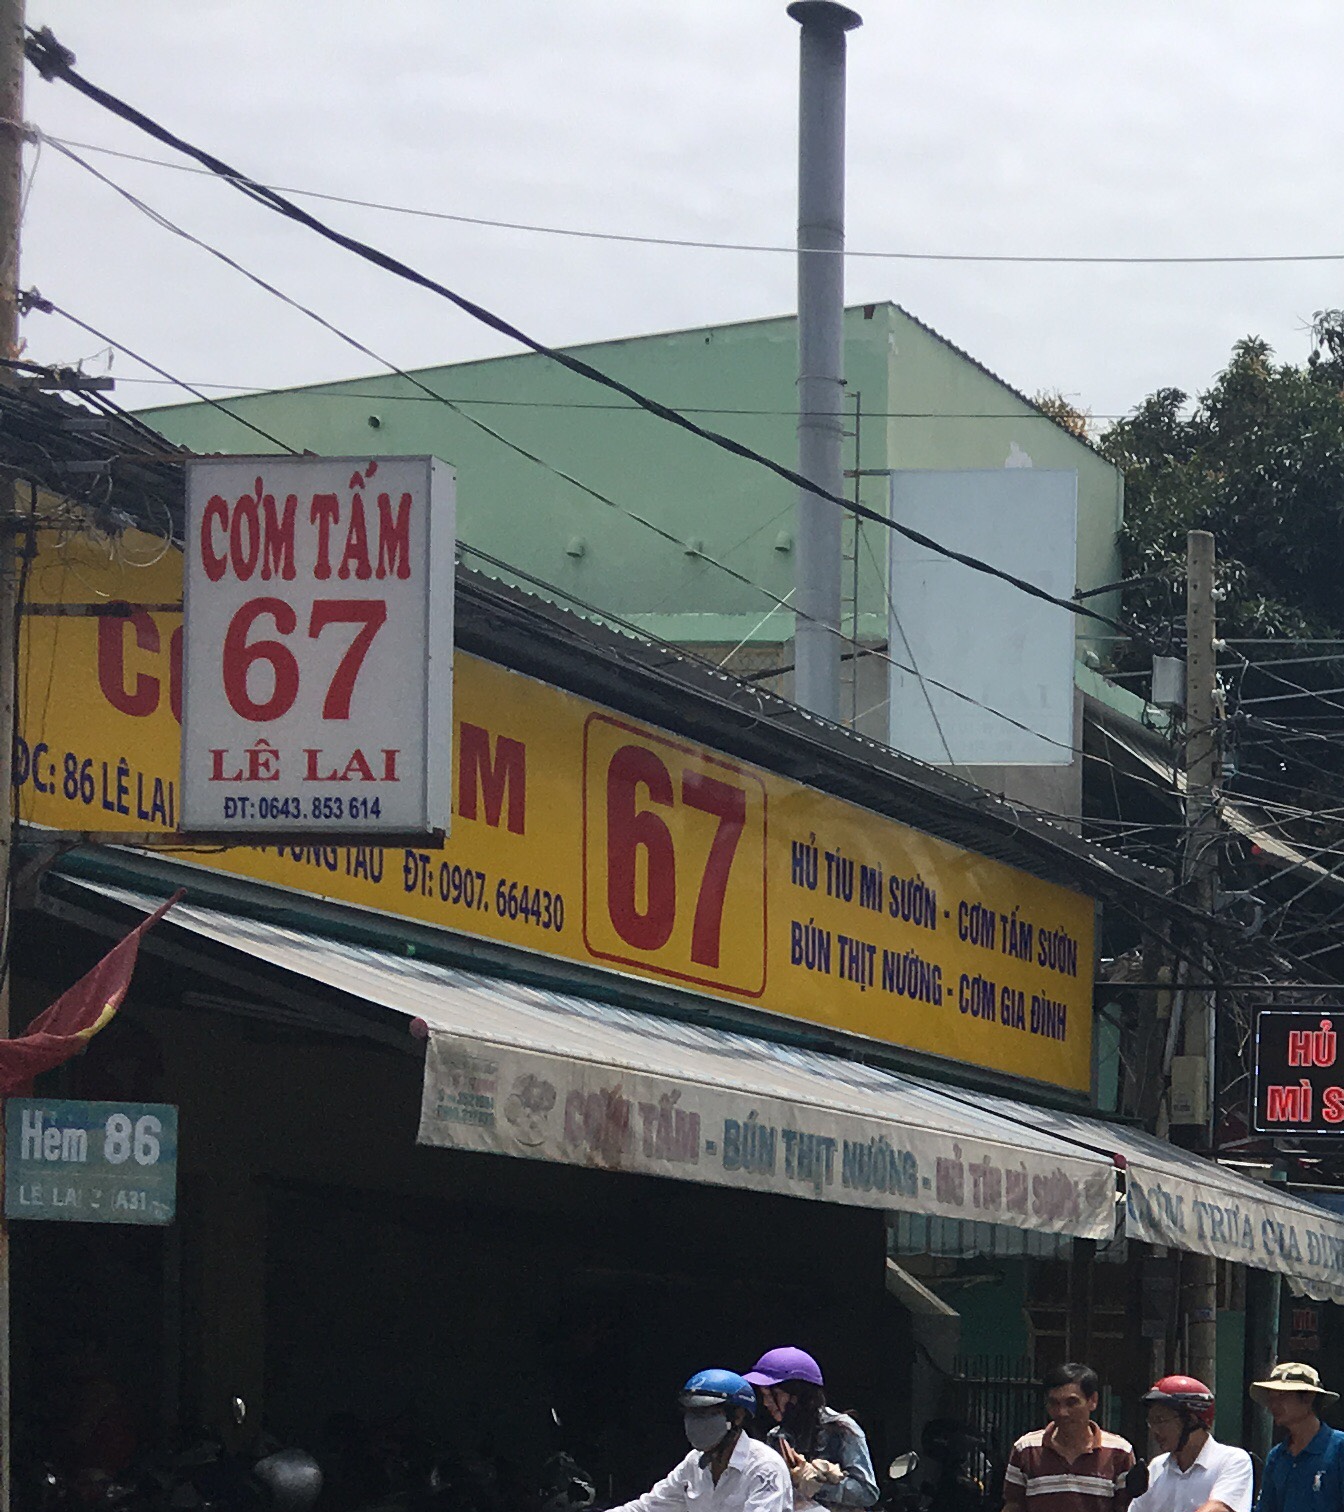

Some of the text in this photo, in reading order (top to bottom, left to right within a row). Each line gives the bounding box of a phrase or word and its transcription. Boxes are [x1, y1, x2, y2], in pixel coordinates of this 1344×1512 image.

[200, 460, 412, 582] CƠM TẤM
[222, 597, 389, 722] 67
[63, 752, 95, 804] 86
[102, 756, 130, 816] LÊ
[208, 738, 402, 783] LÊ LAI
[311, 797, 344, 820] 853
[349, 796, 382, 820] 614
[403, 849, 434, 898] ĐT:
[496, 878, 565, 933] 664430
[606, 744, 747, 970] 67
[791, 831, 819, 891] HỦ
[825, 847, 855, 903] TÍU
[889, 873, 938, 931] SƯỜN
[958, 900, 997, 951] CƠM
[791, 917, 832, 976] BÚN
[838, 934, 877, 993] THỊT
[958, 973, 997, 1023] CƠM
[1001, 986, 1027, 1032] GIA
[1288, 1019, 1338, 1068] HỦ
[1267, 1078, 1313, 1123] MÌ
[104, 1113, 163, 1166] 86
